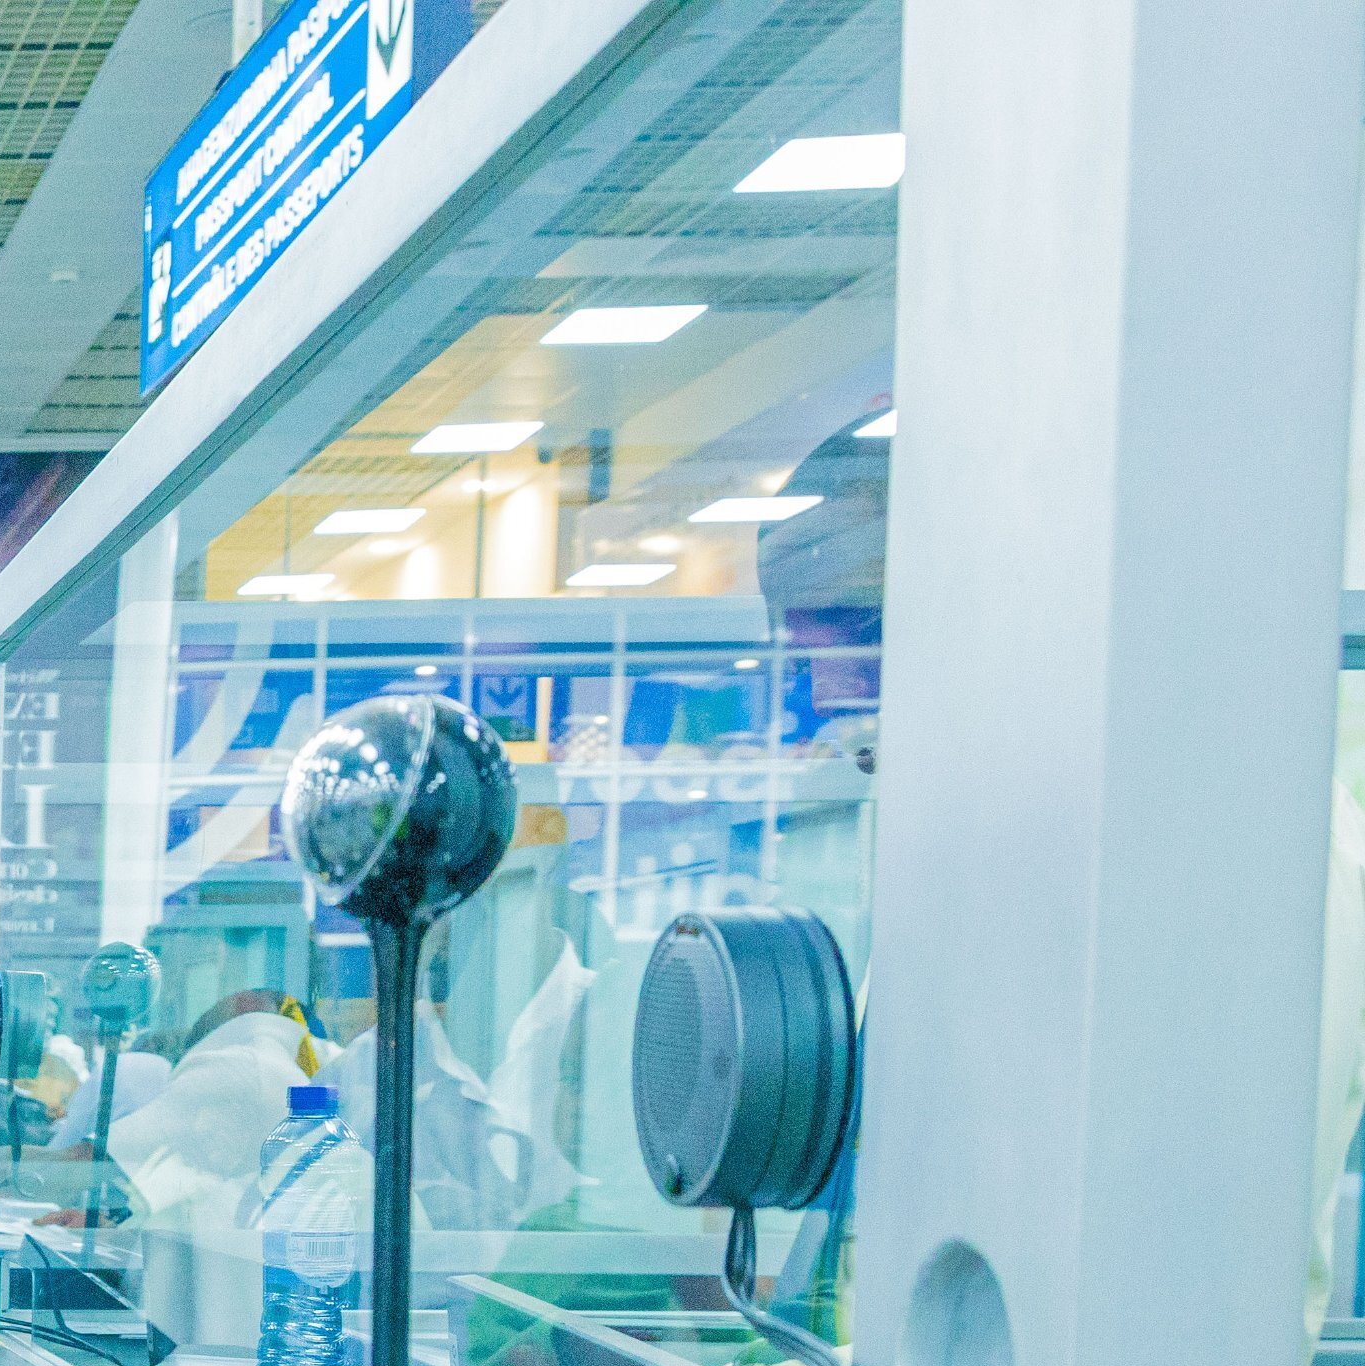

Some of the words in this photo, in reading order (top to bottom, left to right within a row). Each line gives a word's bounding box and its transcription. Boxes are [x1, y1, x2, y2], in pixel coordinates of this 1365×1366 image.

[195, 146, 263, 251] PASSPORT
[263, 71, 335, 177] CONTROL
[236, 228, 265, 286] DES
[264, 123, 364, 257] PASSEPORTS
